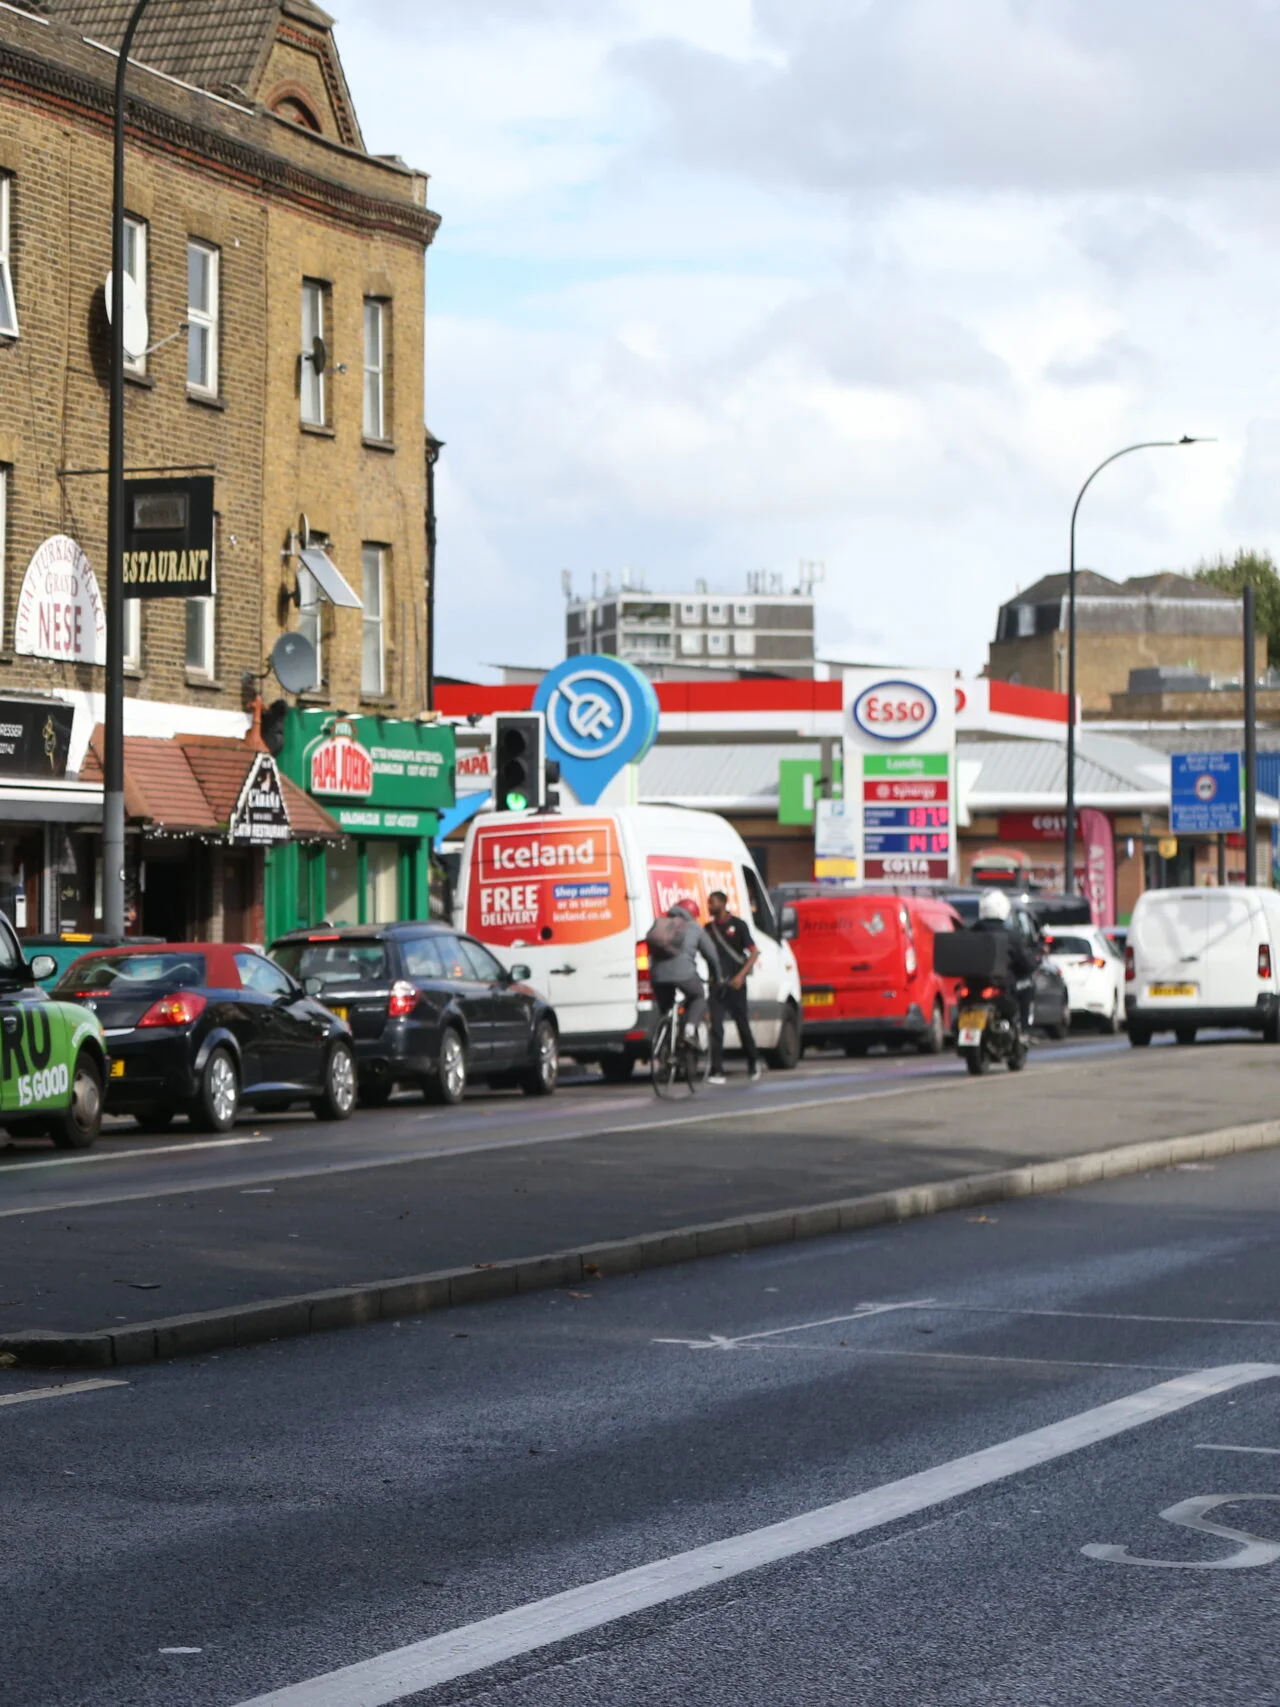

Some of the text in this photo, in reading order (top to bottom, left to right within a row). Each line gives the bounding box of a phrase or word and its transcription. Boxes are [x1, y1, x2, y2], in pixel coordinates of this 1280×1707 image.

[122, 549, 209, 584] ESTAURANT
[45, 572, 78, 597] GRAND
[38, 601, 83, 653] NESE
[865, 696, 925, 722] Esso
[313, 744, 337, 789] PAPA
[457, 755, 489, 775] PAPA
[492, 837, 595, 871] Iceland
[882, 859, 930, 873] COSTA
[480, 884, 540, 914] FREE
[554, 885, 609, 898] Shop online
[481, 910, 539, 927] DELIVERY
[32, 1062, 68, 1102] GOOD
